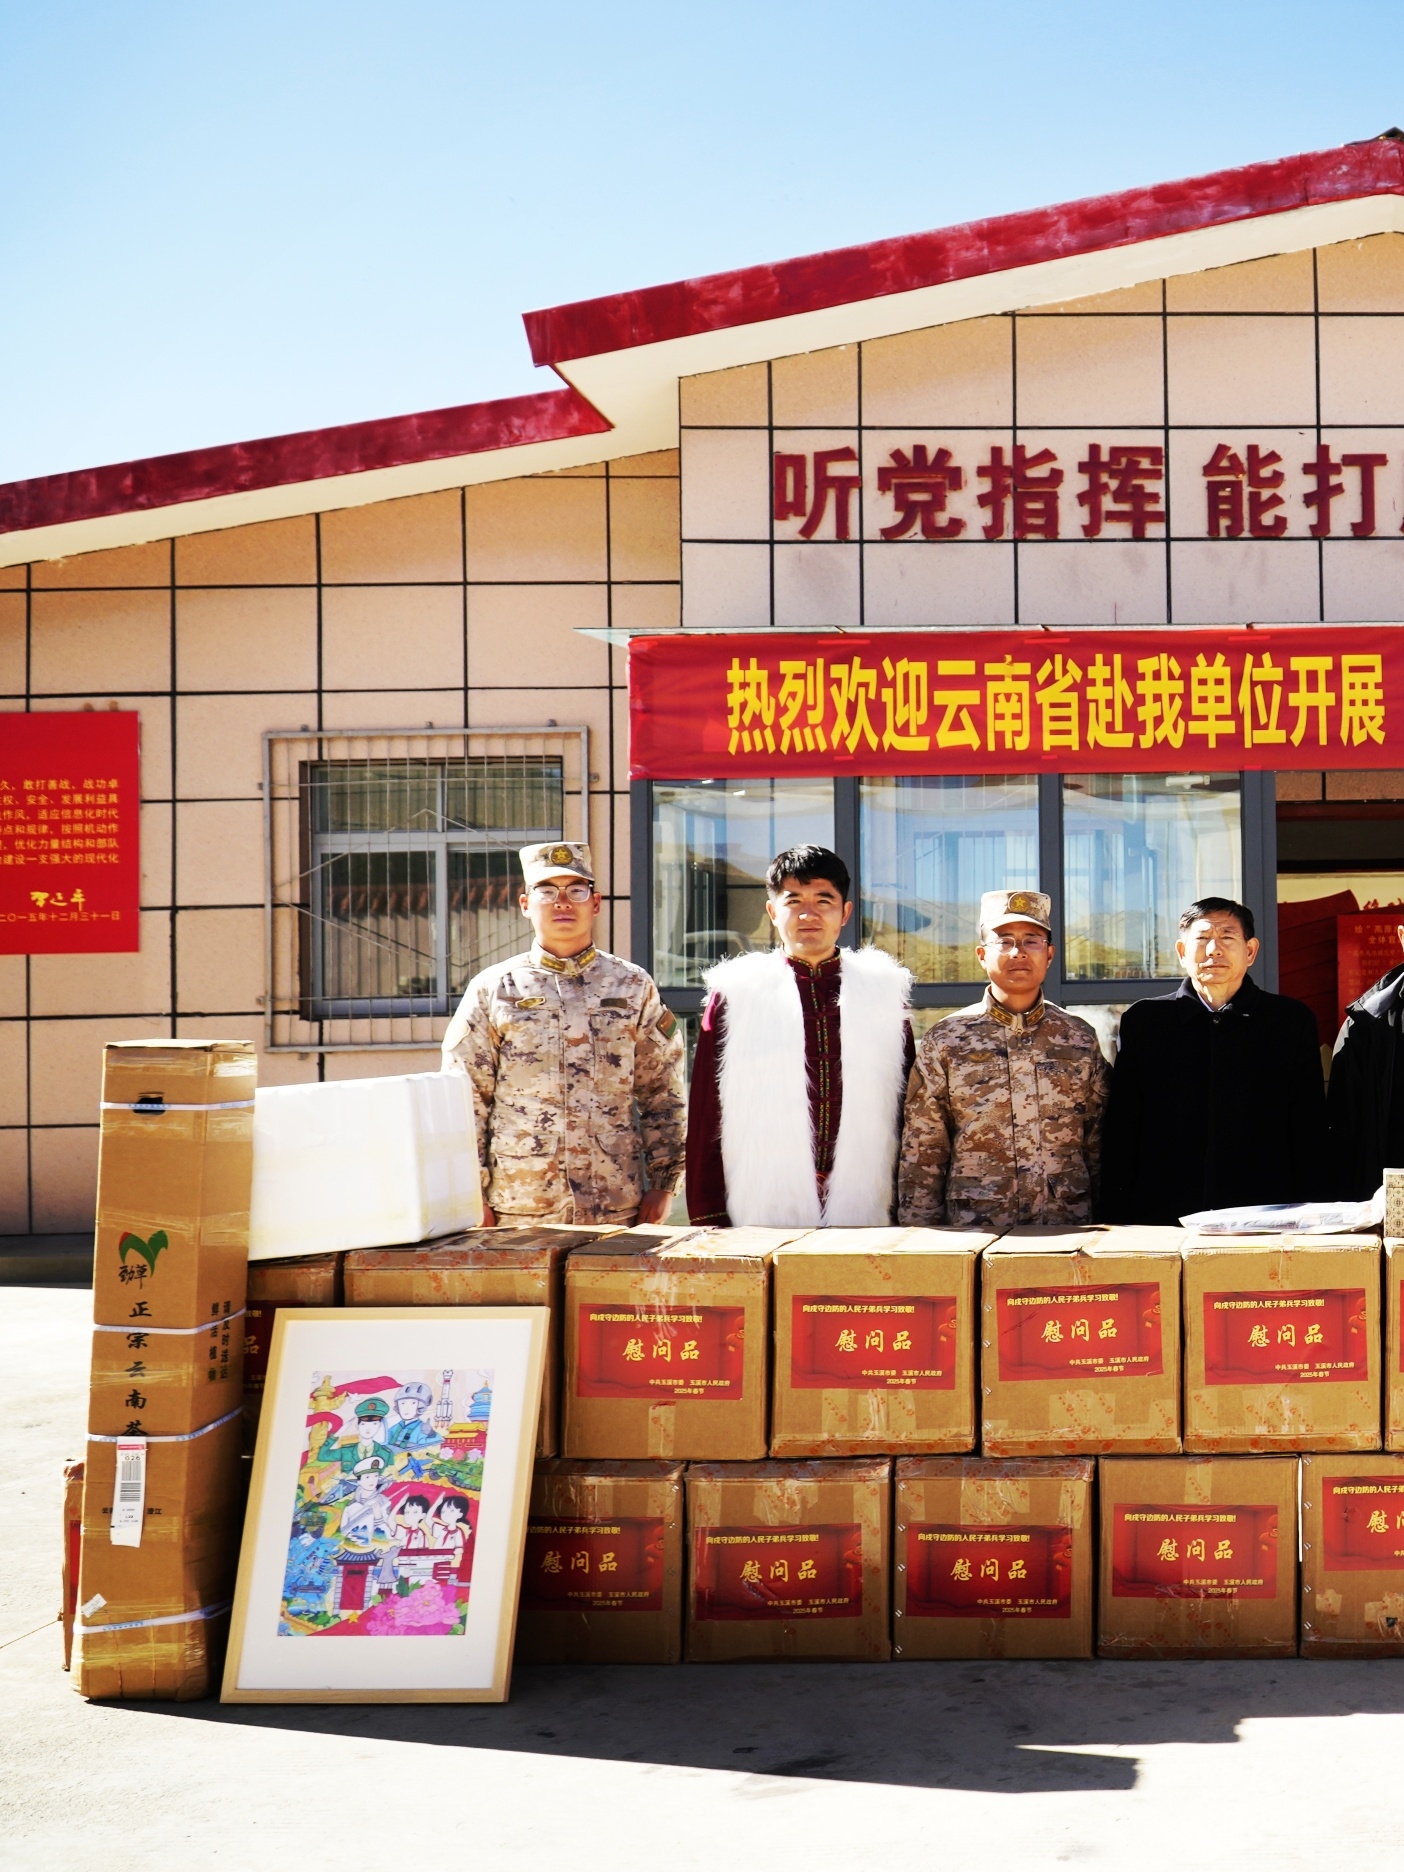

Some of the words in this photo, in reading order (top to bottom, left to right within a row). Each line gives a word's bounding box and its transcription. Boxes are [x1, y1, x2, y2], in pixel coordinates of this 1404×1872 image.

[773, 443, 1166, 540] 听党指挥
[0, 809, 119, 820] 作风，适应信息化时代
[0, 853, 119, 865] 建设一支强大的现代化
[835, 1329, 912, 1352] 慰问品
[1041, 1318, 1118, 1342] 慰问品
[1248, 1324, 1324, 1347] 慰问品
[622, 1338, 699, 1362] 慰问品
[526, 1526, 620, 1535] 边防的人民子弟兵学习致敬!
[540, 1550, 618, 1574] 慰问品
[1157, 1539, 1233, 1562] 慰问品
[740, 1559, 818, 1583] 慰问品
[950, 1558, 1028, 1582] 慰问品
